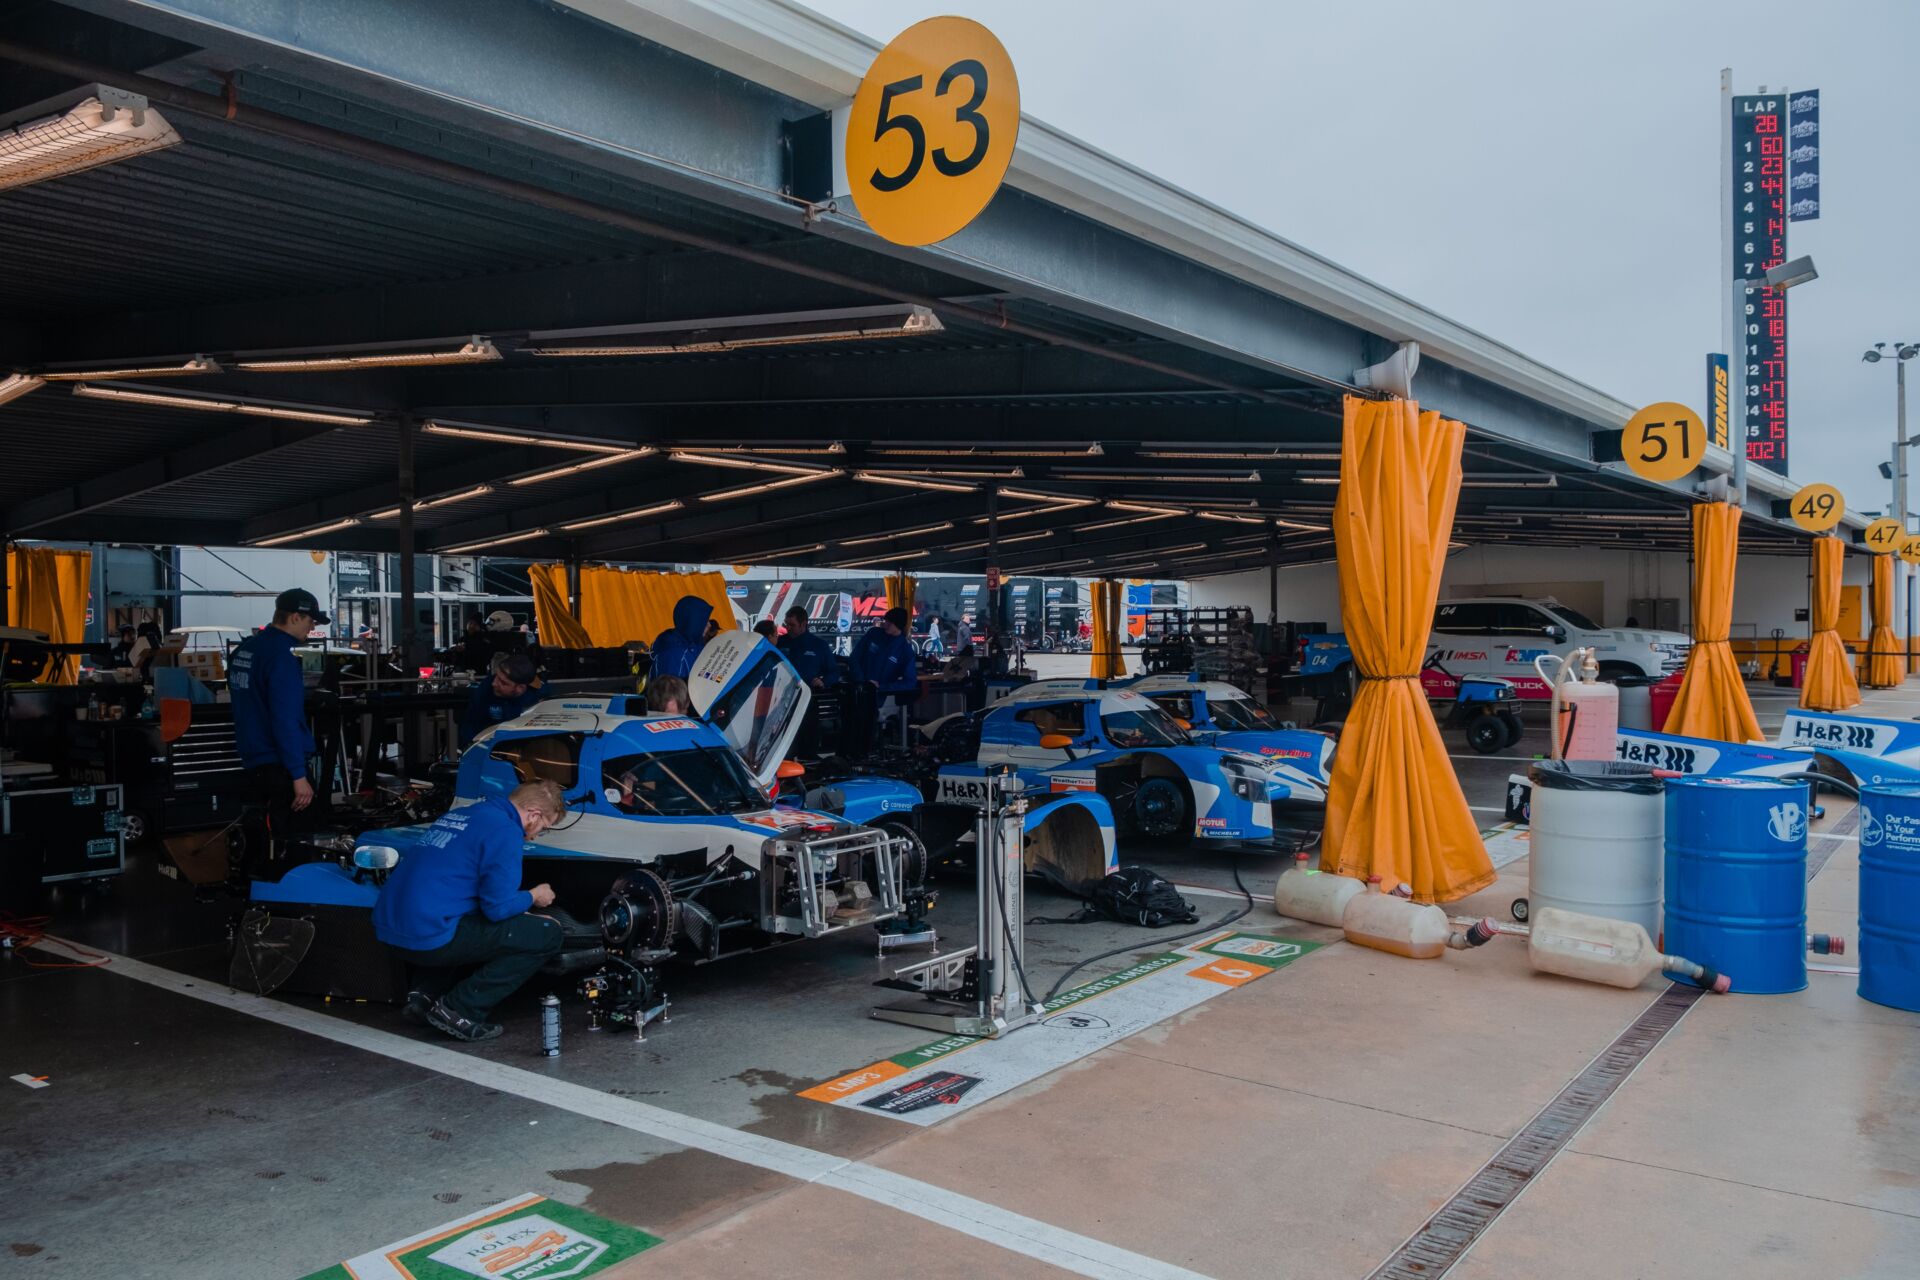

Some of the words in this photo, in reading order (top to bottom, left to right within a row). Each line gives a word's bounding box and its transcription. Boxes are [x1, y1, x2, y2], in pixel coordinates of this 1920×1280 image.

[1744, 102, 1776, 112] LAP
[870, 59, 990, 192] 53
[1755, 115, 1777, 133] 28
[1744, 142, 1752, 152] 1
[1762, 137, 1783, 154] 60
[1744, 162, 1753, 172] 2
[1762, 157, 1783, 174] 23
[1744, 182, 1753, 193] 3
[1762, 178, 1783, 194] 44
[1744, 202, 1754, 213] 4
[1772, 198, 1783, 214] 4
[1744, 222, 1754, 233] 5
[1769, 219, 1783, 235] 14
[1744, 243, 1754, 254] 6
[1773, 239, 1783, 256] 6
[1744, 263, 1754, 274] 7
[1745, 304, 1755, 315] 9
[1763, 299, 1784, 317] 30
[1769, 320, 1784, 336] 18
[1773, 340, 1784, 357] 3
[1763, 361, 1784, 378] 77
[1763, 381, 1784, 398] 47
[1763, 401, 1784, 418] 46
[1769, 421, 1784, 438] 15
[1640, 420, 1690, 462] 51
[1798, 493, 1835, 519] 49
[1870, 526, 1899, 543] 47
[1441, 607, 1456, 615] 04
[1312, 655, 1328, 665] 04
[1454, 652, 1488, 660] IMSA
[1796, 721, 1843, 742] H&R
[1259, 745, 1288, 758] Spray
[1287, 749, 1312, 759] Nine
[943, 780, 979, 797] H&R
[1199, 819, 1225, 827] MOTUL
[1769, 803, 1800, 840] VP
[1885, 814, 1902, 823] Our
[1894, 825, 1915, 834] Your
[1118, 957, 1176, 984] AMERICA
[1209, 966, 1253, 978] 6
[916, 1036, 977, 1059] MUEH
[827, 1072, 881, 1093] LMP3
[466, 1228, 538, 1258] ROLEX
[480, 1230, 568, 1273] 24
[511, 1244, 592, 1279] DAYTONA
